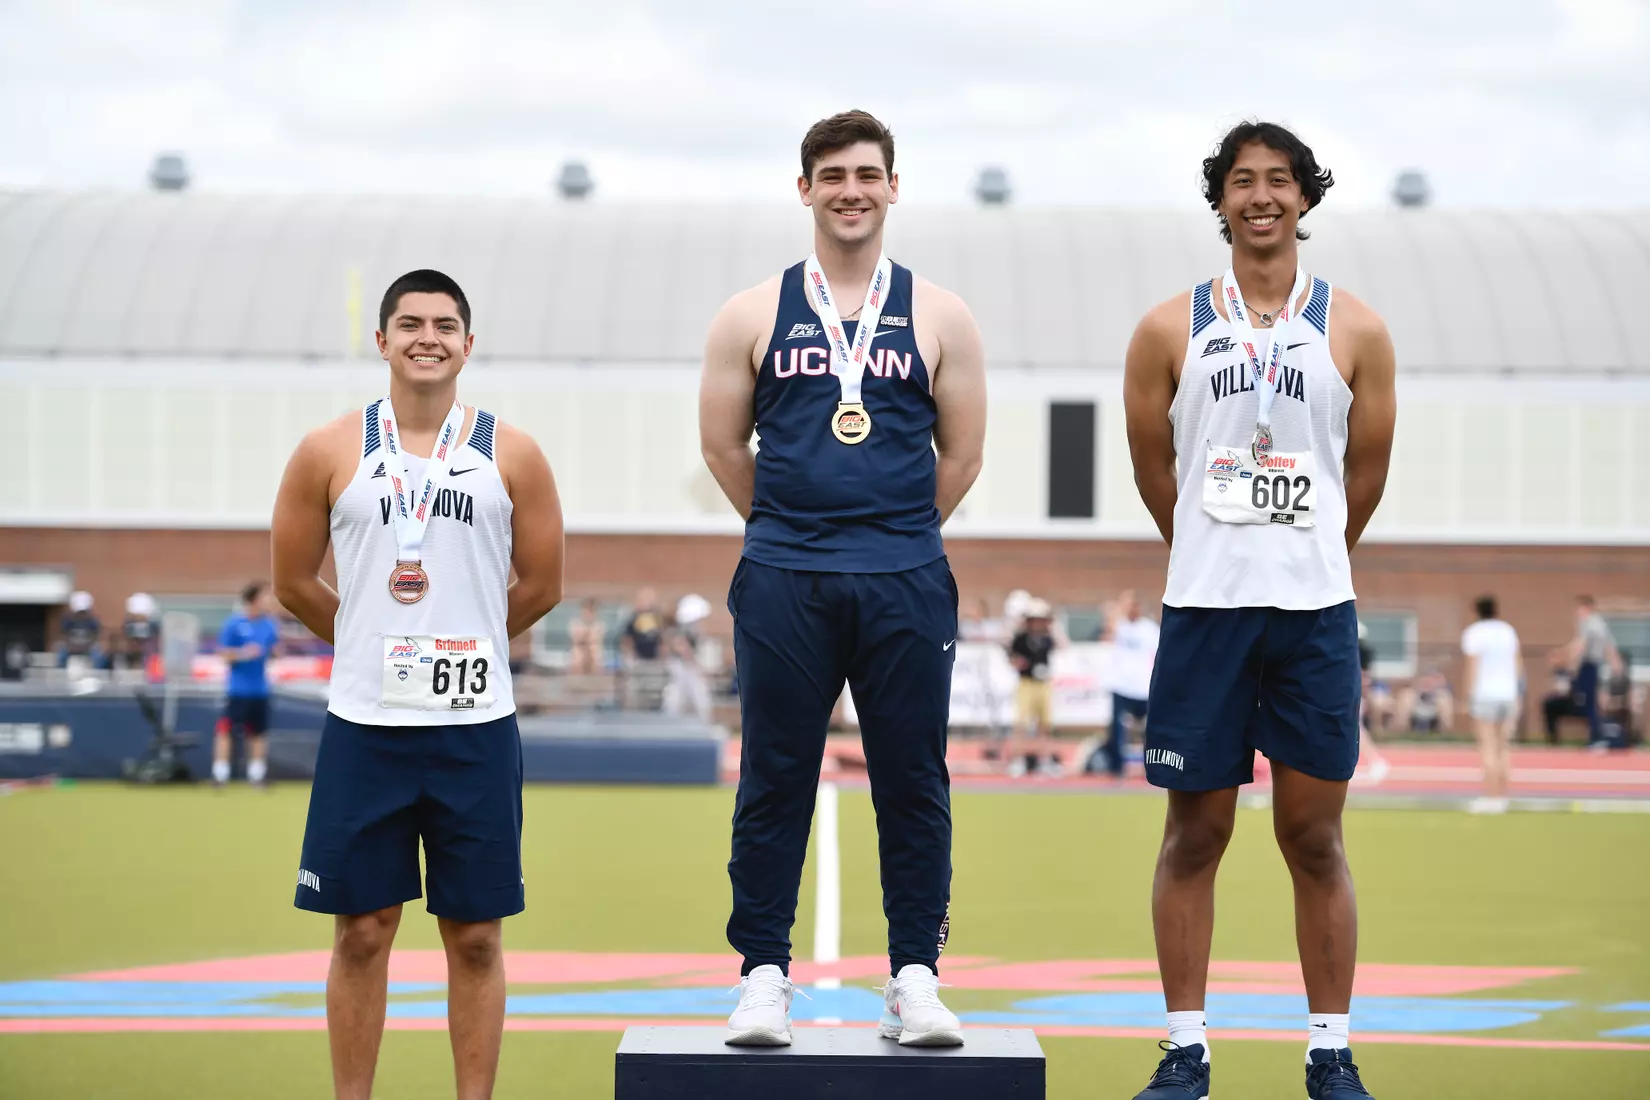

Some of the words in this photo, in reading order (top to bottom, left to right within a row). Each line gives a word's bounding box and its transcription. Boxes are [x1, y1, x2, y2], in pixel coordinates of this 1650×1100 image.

[814, 272, 823, 285] BIG
[870, 291, 878, 306] BIG
[874, 269, 884, 292] EAST
[818, 284, 831, 307] EAST
[1229, 286, 1237, 301] BIG
[1232, 300, 1245, 321] EAST
[832, 325, 842, 341] BIG
[857, 323, 868, 348] EAST
[1207, 336, 1231, 345] BIG
[836, 340, 849, 363] EAST
[853, 347, 862, 362] BIG
[1203, 343, 1238, 354] EAST
[1246, 342, 1257, 358] BIG
[1270, 341, 1281, 367] EAST
[774, 346, 912, 380] UCNN
[1267, 366, 1277, 384] BIG
[387, 432, 397, 455] EAST
[436, 443, 446, 460] BIG
[441, 423, 454, 445] EAST
[1210, 464, 1240, 472] EAST
[395, 477, 404, 493] BIG
[1251, 474, 1311, 511] 602
[397, 492, 408, 520] EAST
[415, 502, 425, 520] BIG
[420, 478, 433, 504] EAST
[432, 657, 489, 695] 613
[1145, 748, 1184, 771] VILLANOVA
